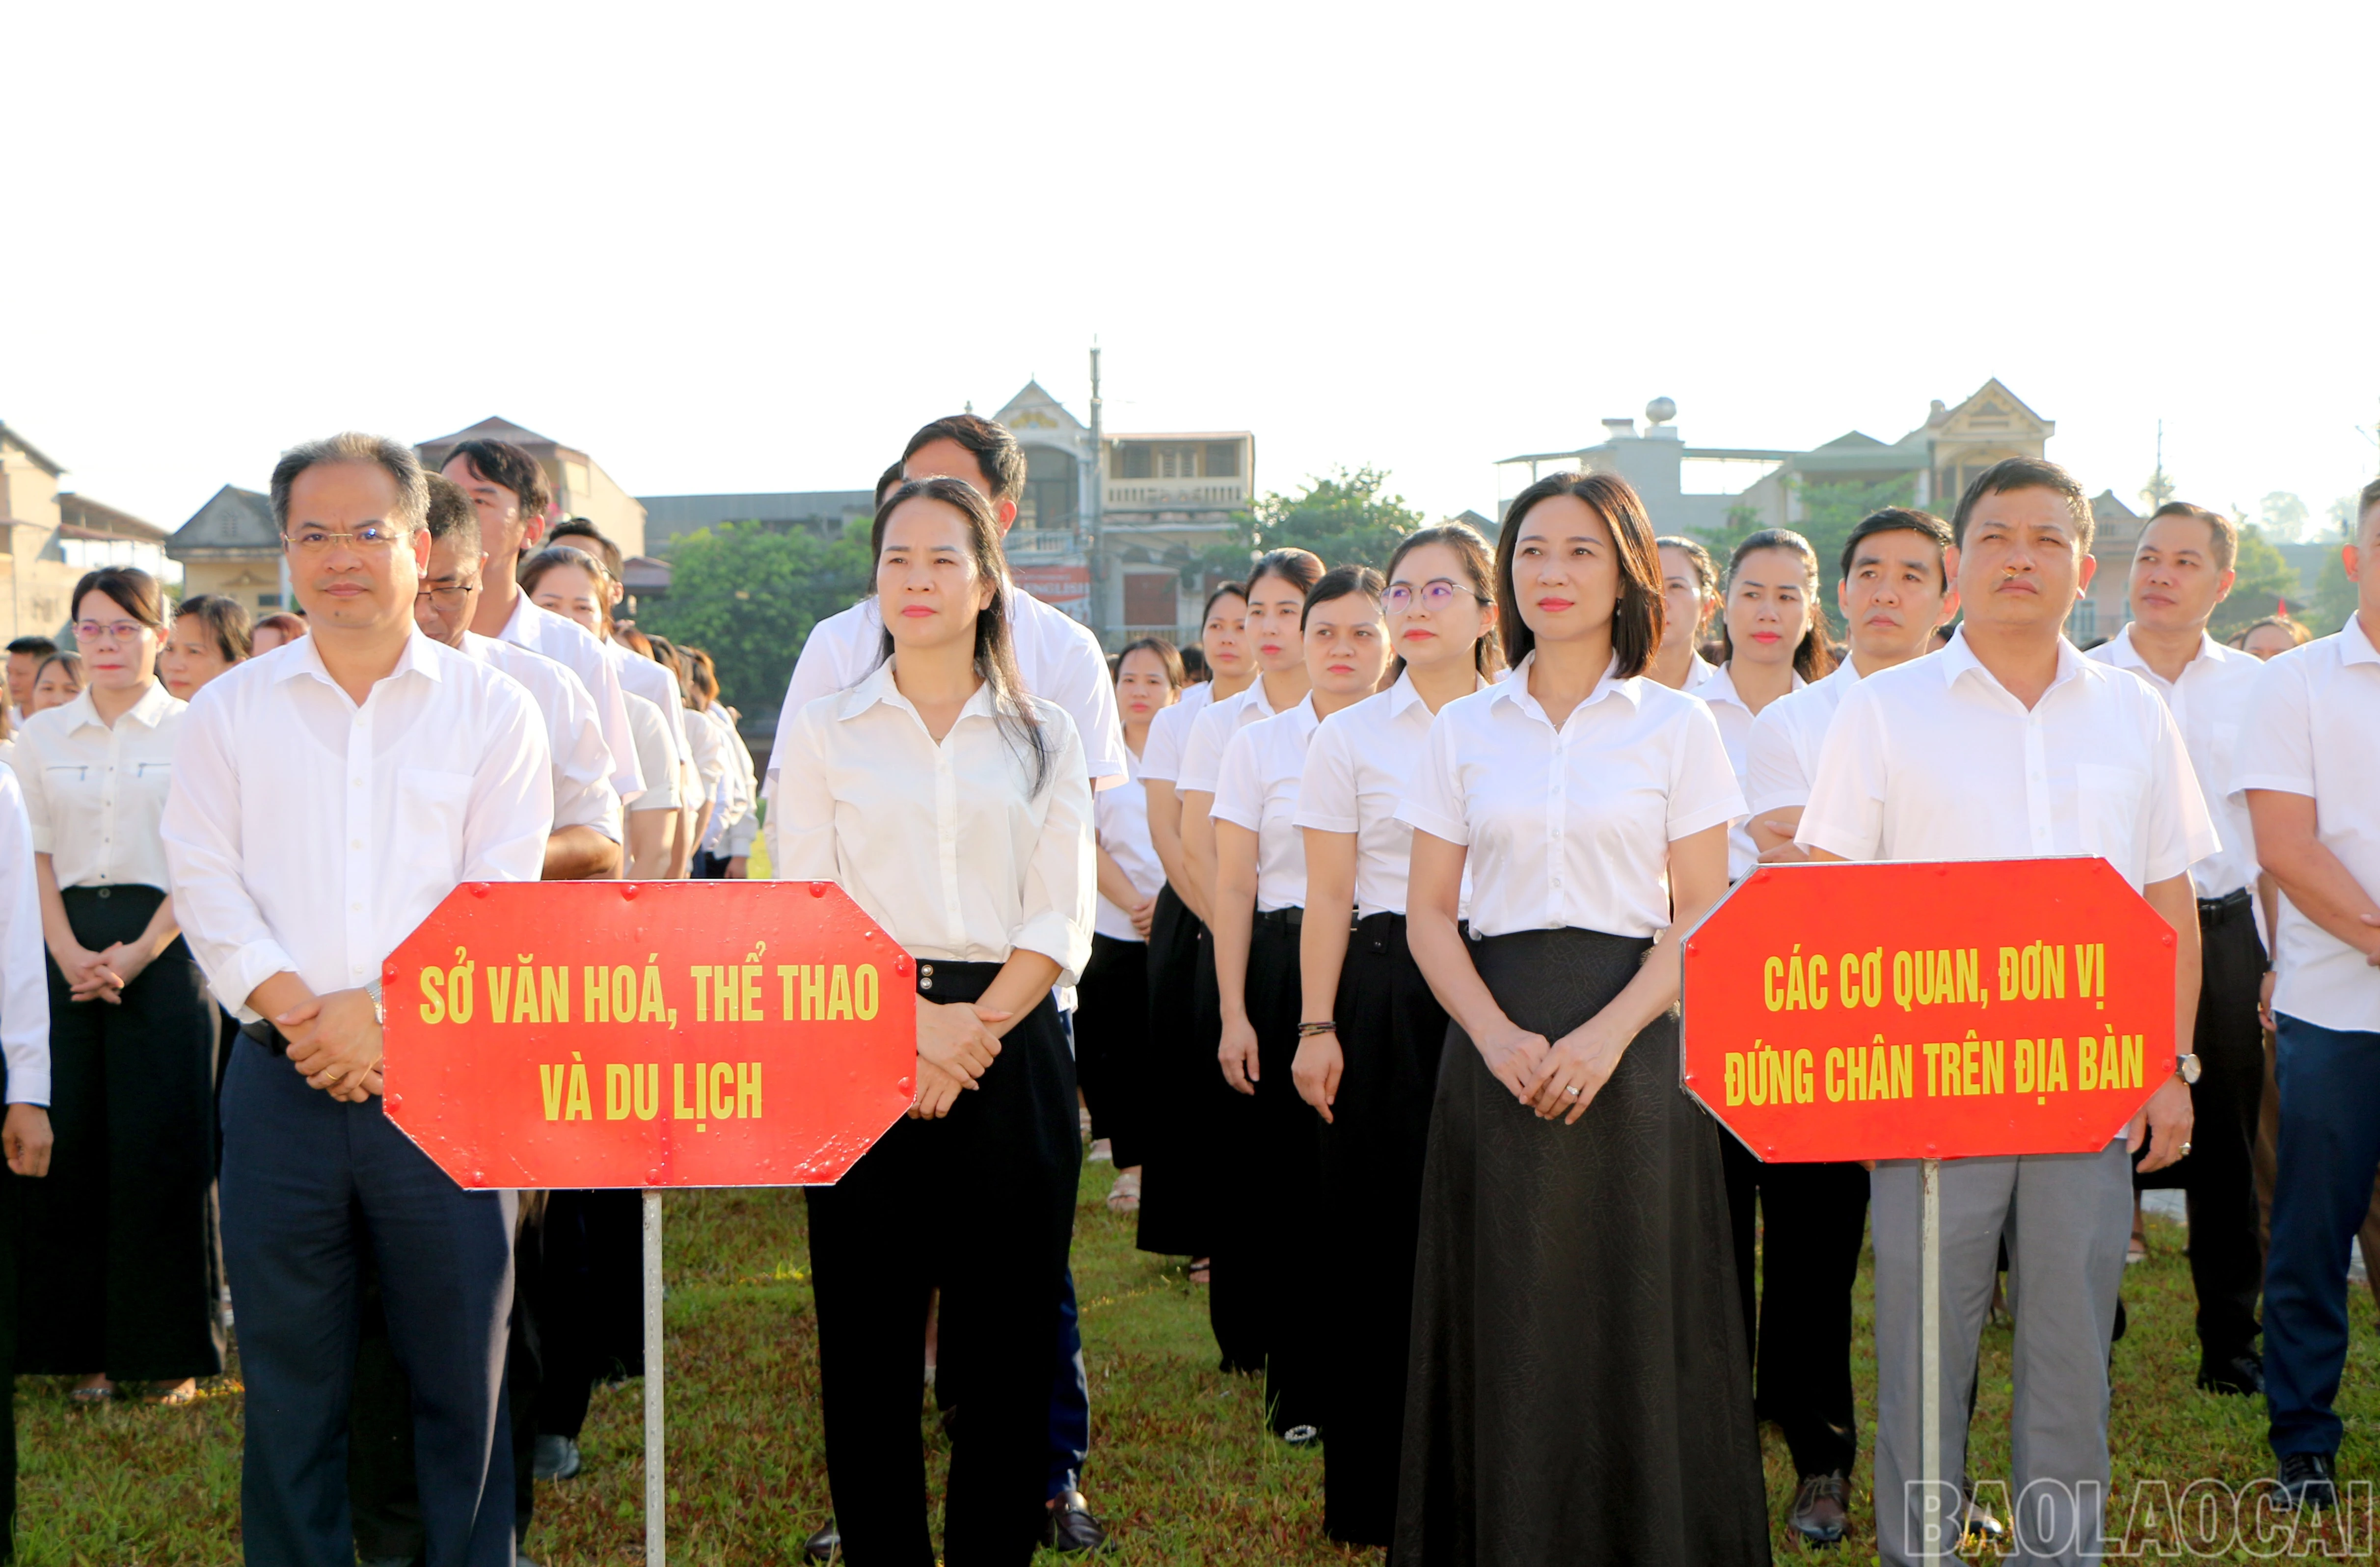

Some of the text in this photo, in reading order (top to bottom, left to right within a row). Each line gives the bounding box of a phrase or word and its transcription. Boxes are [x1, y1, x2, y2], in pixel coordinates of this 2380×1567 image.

[419, 940, 879, 1030] SỞ VĂN HOÁ, THỂ THAO
[1764, 940, 2105, 1012] CÁC CƠ QUAN, ĐƠN VỊ
[539, 1051, 762, 1133] VÀ DU LỊCH
[1724, 1024, 2143, 1107] ĐỨNG CHÂN TRÊN ĐỊA BÀN
